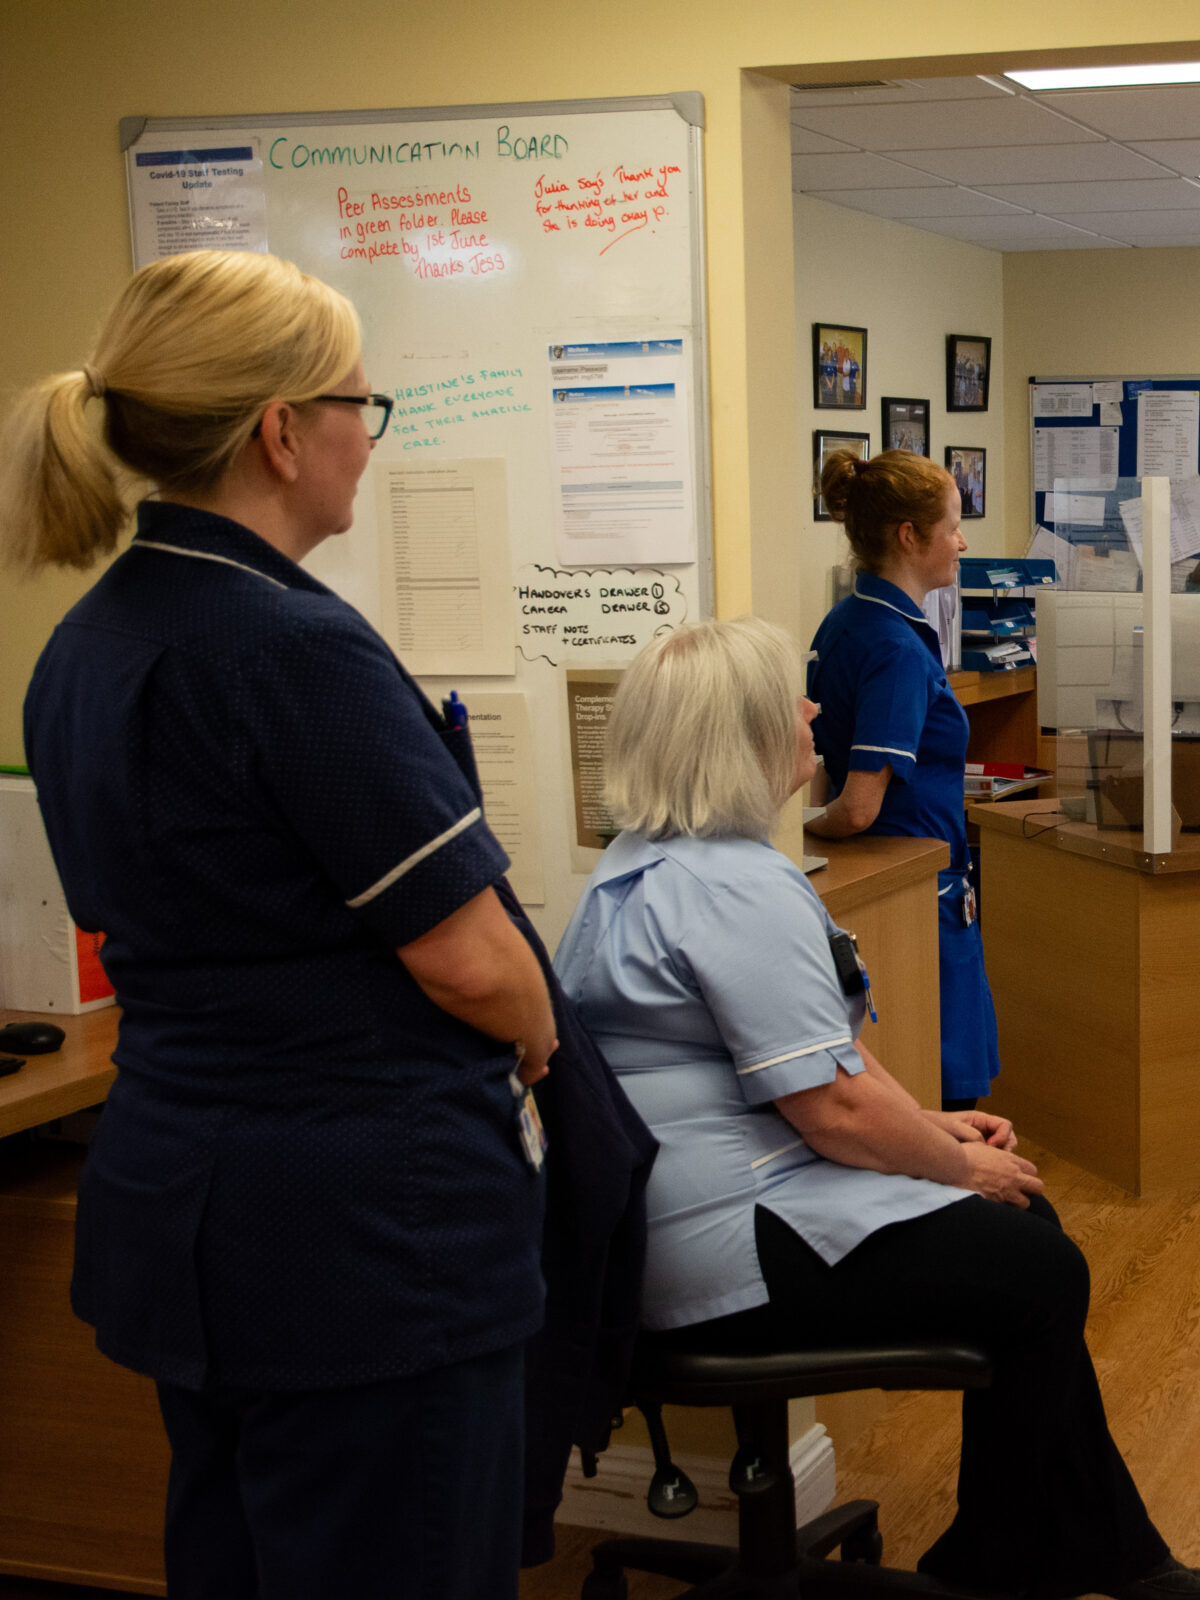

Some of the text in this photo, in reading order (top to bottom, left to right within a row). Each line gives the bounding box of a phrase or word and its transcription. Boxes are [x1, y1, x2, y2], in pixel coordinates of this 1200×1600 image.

[268, 125, 569, 169] COMMUNICATION BOARD
[149, 170, 187, 180] Covid-19
[211, 168, 244, 177] Testing
[182, 181, 213, 190] Update
[534, 174, 570, 198] Julia
[613, 165, 654, 184] Thank
[656, 165, 682, 188] you
[337, 184, 472, 219] Peer Assessments
[535, 200, 551, 216] for
[644, 187, 669, 198] and
[339, 226, 352, 240] in
[356, 219, 391, 244] green
[450, 208, 489, 226] Please
[566, 215, 578, 229] is
[584, 214, 616, 232] doing
[340, 229, 489, 264] complete by 1st June
[414, 252, 505, 279] Thanks Jess
[385, 368, 523, 401] HRISTINE'S FAMILY
[391, 386, 515, 419] THANK EVERYONE
[392, 404, 532, 435] FOR THEIR AMAZING
[518, 585, 591, 599] HANDOVERS
[600, 587, 650, 598] DRAWER
[522, 604, 568, 615] CAMERA
[601, 603, 651, 614] DRAWER
[523, 624, 558, 635] STAFF
[572, 635, 637, 646] CERTIFICATES
[575, 703, 605, 713] Therapy
